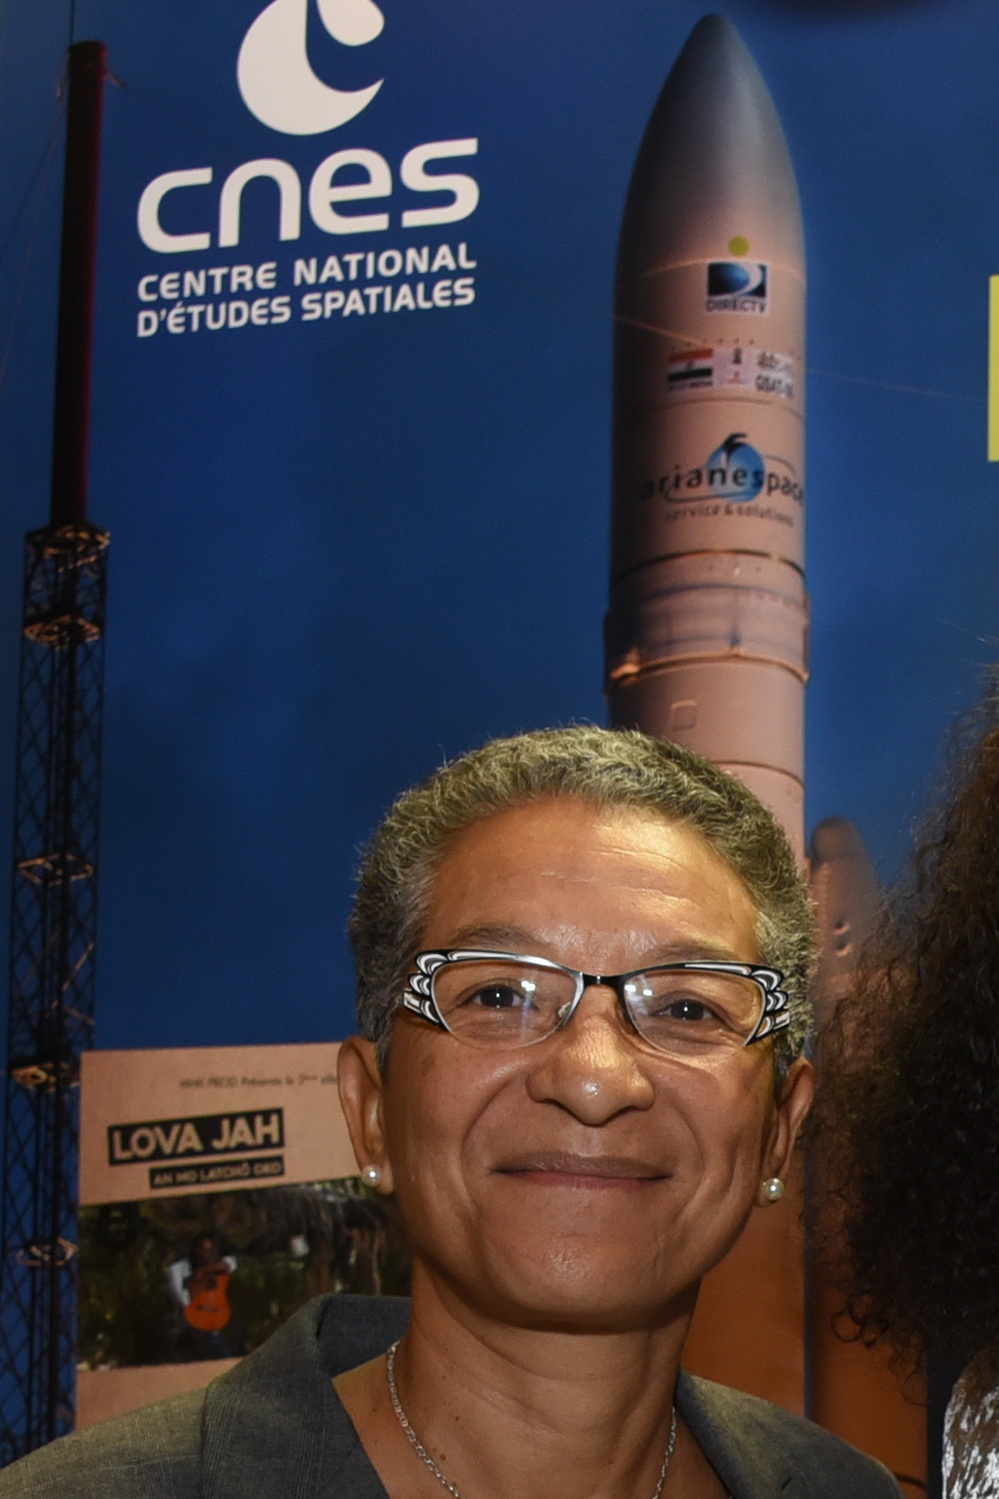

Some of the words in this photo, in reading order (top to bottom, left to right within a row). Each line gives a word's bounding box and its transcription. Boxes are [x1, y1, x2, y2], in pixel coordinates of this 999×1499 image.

[137, 137, 480, 254] cnes
[137, 262, 277, 302] CENTRE
[293, 242, 477, 287] NATIONAL
[137, 295, 292, 338] D'ÉTUDES
[301, 277, 476, 321] SPATIALES
[112, 1122, 204, 1161] LOVA
[211, 1112, 280, 1150] JAH
